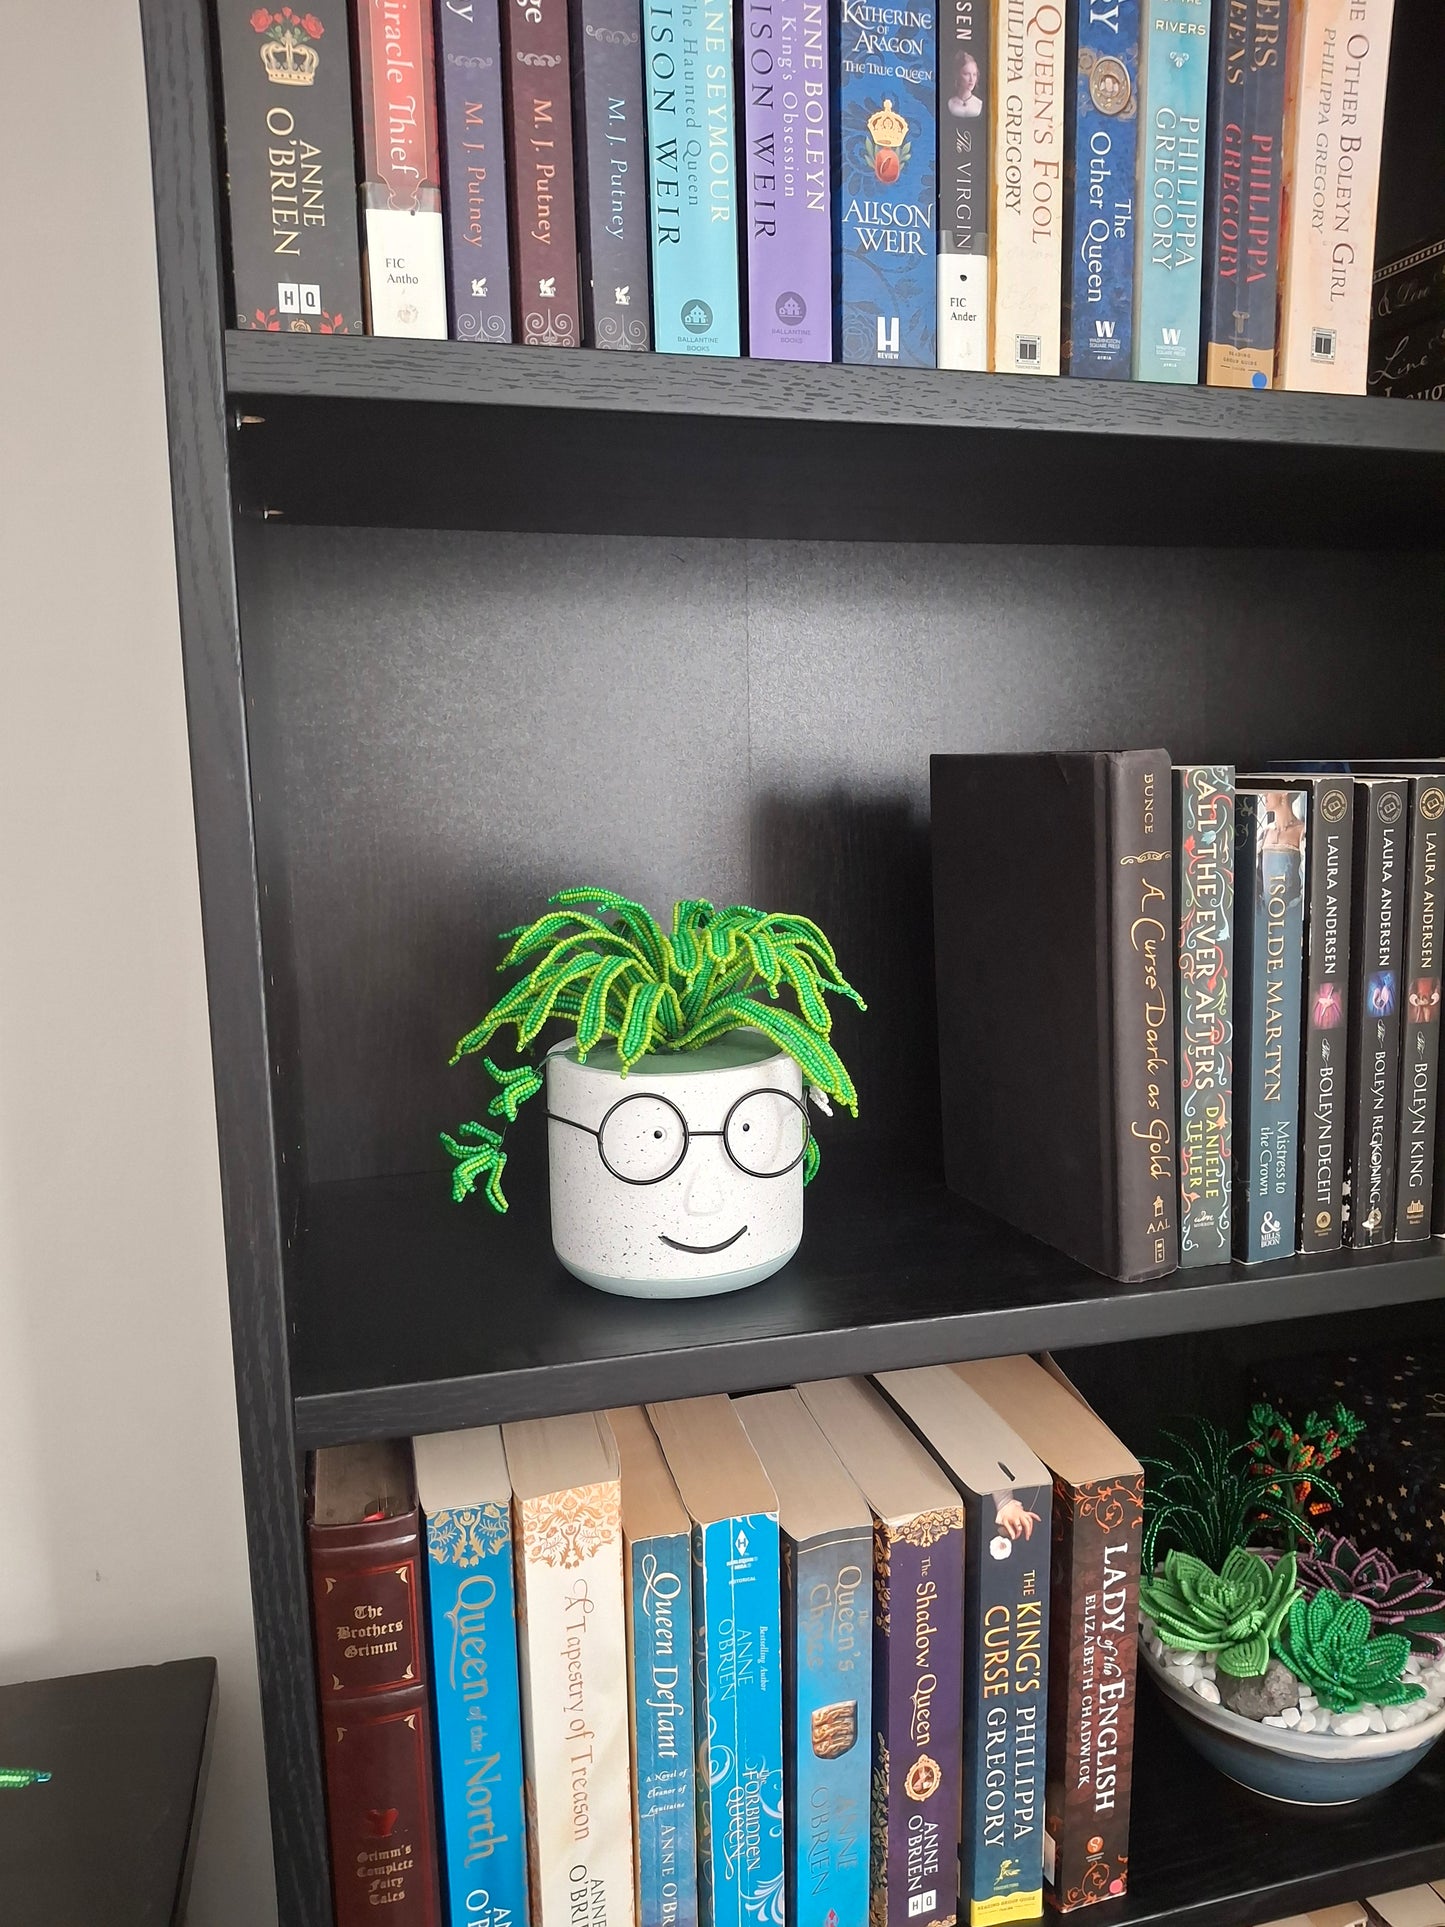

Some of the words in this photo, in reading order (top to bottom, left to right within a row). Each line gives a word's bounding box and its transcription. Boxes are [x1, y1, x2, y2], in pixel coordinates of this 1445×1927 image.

[842, 0, 933, 30] KATHERINE
[852, 30, 925, 55] ARAGON
[876, 25, 890, 35] OF
[1155, 19, 1207, 36] RIVERS
[777, 16, 797, 81] King's
[842, 60, 866, 74] THE
[866, 63, 894, 77] TRUE
[895, 66, 933, 84] QUEEN
[1026, 4, 1062, 145] QUEEN'S
[1317, 27, 1337, 126] PHILIPPA
[683, 39, 702, 129] Haunted
[1341, 34, 1370, 127] OTHER
[388, 95, 420, 179] Thief
[464, 101, 484, 130] M.
[533, 99, 553, 129] M.
[605, 133, 627, 146] J.
[608, 97, 626, 126] M.
[956, 128, 972, 154] The
[462, 141, 485, 153] J.
[530, 137, 554, 152] J.
[682, 139, 702, 206] Queen
[706, 64, 730, 223] SEYMOUR
[782, 92, 799, 197] Obsession
[804, 80, 825, 212] BOLEYN
[1005, 95, 1023, 216] GREGORY
[1089, 131, 1112, 209] Other
[266, 107, 301, 257] O'BRIEN
[299, 139, 326, 228] ANNE
[463, 166, 487, 248] Putney
[531, 163, 555, 245] Putney
[605, 159, 628, 240] Putney
[655, 137, 681, 246] WEIR
[752, 132, 777, 240] WEIR
[1032, 158, 1060, 244] FOOL
[1151, 107, 1177, 272] GREGORY
[1175, 116, 1200, 267] PHILIPPA
[1219, 122, 1242, 284] GREGORY
[1245, 134, 1273, 283] PHILIPPA
[1311, 132, 1329, 235] GREGORY
[1334, 135, 1362, 233] BOLEYN
[841, 199, 934, 229] ALISON
[853, 227, 928, 256] WEIR
[1113, 198, 1132, 239] The
[385, 258, 405, 269] FIC
[386, 273, 419, 285] Antho
[1081, 219, 1110, 303] Queen
[1330, 242, 1355, 303] GIRL
[284, 291, 316, 308] HQ
[950, 297, 967, 308] FIC
[950, 312, 977, 322] Ander
[1095, 320, 1116, 338] W
[677, 336, 719, 344] BALLANTINE
[771, 328, 811, 336] BALLANTINE
[877, 352, 900, 360] REVIEW
[1161, 327, 1181, 345] W
[1143, 773, 1154, 834] BUNCE
[1196, 777, 1218, 833] ALL
[1196, 842, 1218, 897] THE
[1326, 835, 1339, 890] LAURA
[1381, 828, 1395, 883] LAURA
[1424, 832, 1437, 886] LAURA
[1141, 878, 1165, 913] A
[1266, 873, 1287, 974] ISOLDE
[1130, 917, 1166, 990] Curse
[1195, 910, 1217, 980] EVER
[1324, 895, 1338, 974] ANDERSEN
[1379, 887, 1393, 966] ANDERSEN
[1421, 890, 1435, 968] ANDERSEN
[1145, 986, 1168, 1076] Dark
[1194, 990, 1216, 1090] AFTERS
[1263, 980, 1284, 1102] MARTYN
[1147, 1084, 1160, 1110] as
[1313, 1067, 1334, 1140] BOLEYN
[1370, 1051, 1386, 1110] BOLEYN
[1407, 1063, 1428, 1134] BOLEYN
[1131, 1118, 1172, 1181] Gold
[1189, 1120, 1203, 1188] TELLER
[1205, 1106, 1220, 1199] DANIELLE
[1260, 1126, 1275, 1147] the
[1276, 1120, 1291, 1181] Mistress
[1409, 1141, 1425, 1187] KING
[1259, 1149, 1273, 1197] Crown
[1275, 1182, 1287, 1194] to
[1317, 1144, 1332, 1204] DECEIT
[1260, 1231, 1281, 1242] MILLS
[1260, 1238, 1281, 1249] BOON
[564, 1578, 595, 1614] A
[920, 1555, 932, 1577] The
[1023, 1569, 1036, 1597] THE
[1101, 1542, 1129, 1633] LADY
[336, 1619, 404, 1641] Brothers
[353, 1604, 384, 1621] The
[641, 1553, 682, 1657] Queen
[831, 1565, 863, 1672] Queen's
[915, 1581, 938, 1668] Shadow
[343, 1640, 398, 1659] Grimm
[444, 1575, 497, 1702] Queen
[560, 1615, 587, 1713] Tapestry
[716, 1618, 737, 1702] O'BRIEN
[736, 1628, 754, 1688] ANNE
[757, 1625, 769, 1664] Bestselling
[983, 1605, 1011, 1699] CURSE
[1015, 1600, 1042, 1693] KING'S
[1082, 1593, 1097, 1692] ELIZABETH
[1096, 1635, 1118, 1655] of
[1102, 1654, 1122, 1678] the
[760, 1665, 770, 1692] Author
[466, 1705, 488, 1722] of
[470, 1726, 488, 1752] the
[565, 1718, 595, 1741] of
[646, 1664, 684, 1759] Defiant
[909, 1673, 937, 1747] Queen
[1013, 1704, 1036, 1841] PHILIPPA
[1077, 1695, 1093, 1790] CHADWICK
[1095, 1678, 1126, 1813] ENGLISH
[570, 1744, 593, 1841] Treason
[647, 1786, 676, 1799] Eleanor
[677, 1784, 687, 1794] of
[655, 1769, 677, 1782] Novel
[678, 1768, 689, 1778] of
[984, 1707, 1007, 1848] GREGORY
[464, 1751, 509, 1869] North
[640, 1802, 686, 1819] Aquitaine
[742, 1765, 761, 1871] FORBIDDEN
[835, 1794, 858, 1873] ANNE
[356, 1843, 413, 1864] Grimm's
[356, 1859, 414, 1878] Complete
[660, 1824, 676, 1877] ANNE
[907, 1814, 924, 1892] O'BRIEN
[923, 1821, 939, 1877] ANNE
[368, 1876, 404, 1893] Fairy
[369, 1889, 406, 1906] Tales
